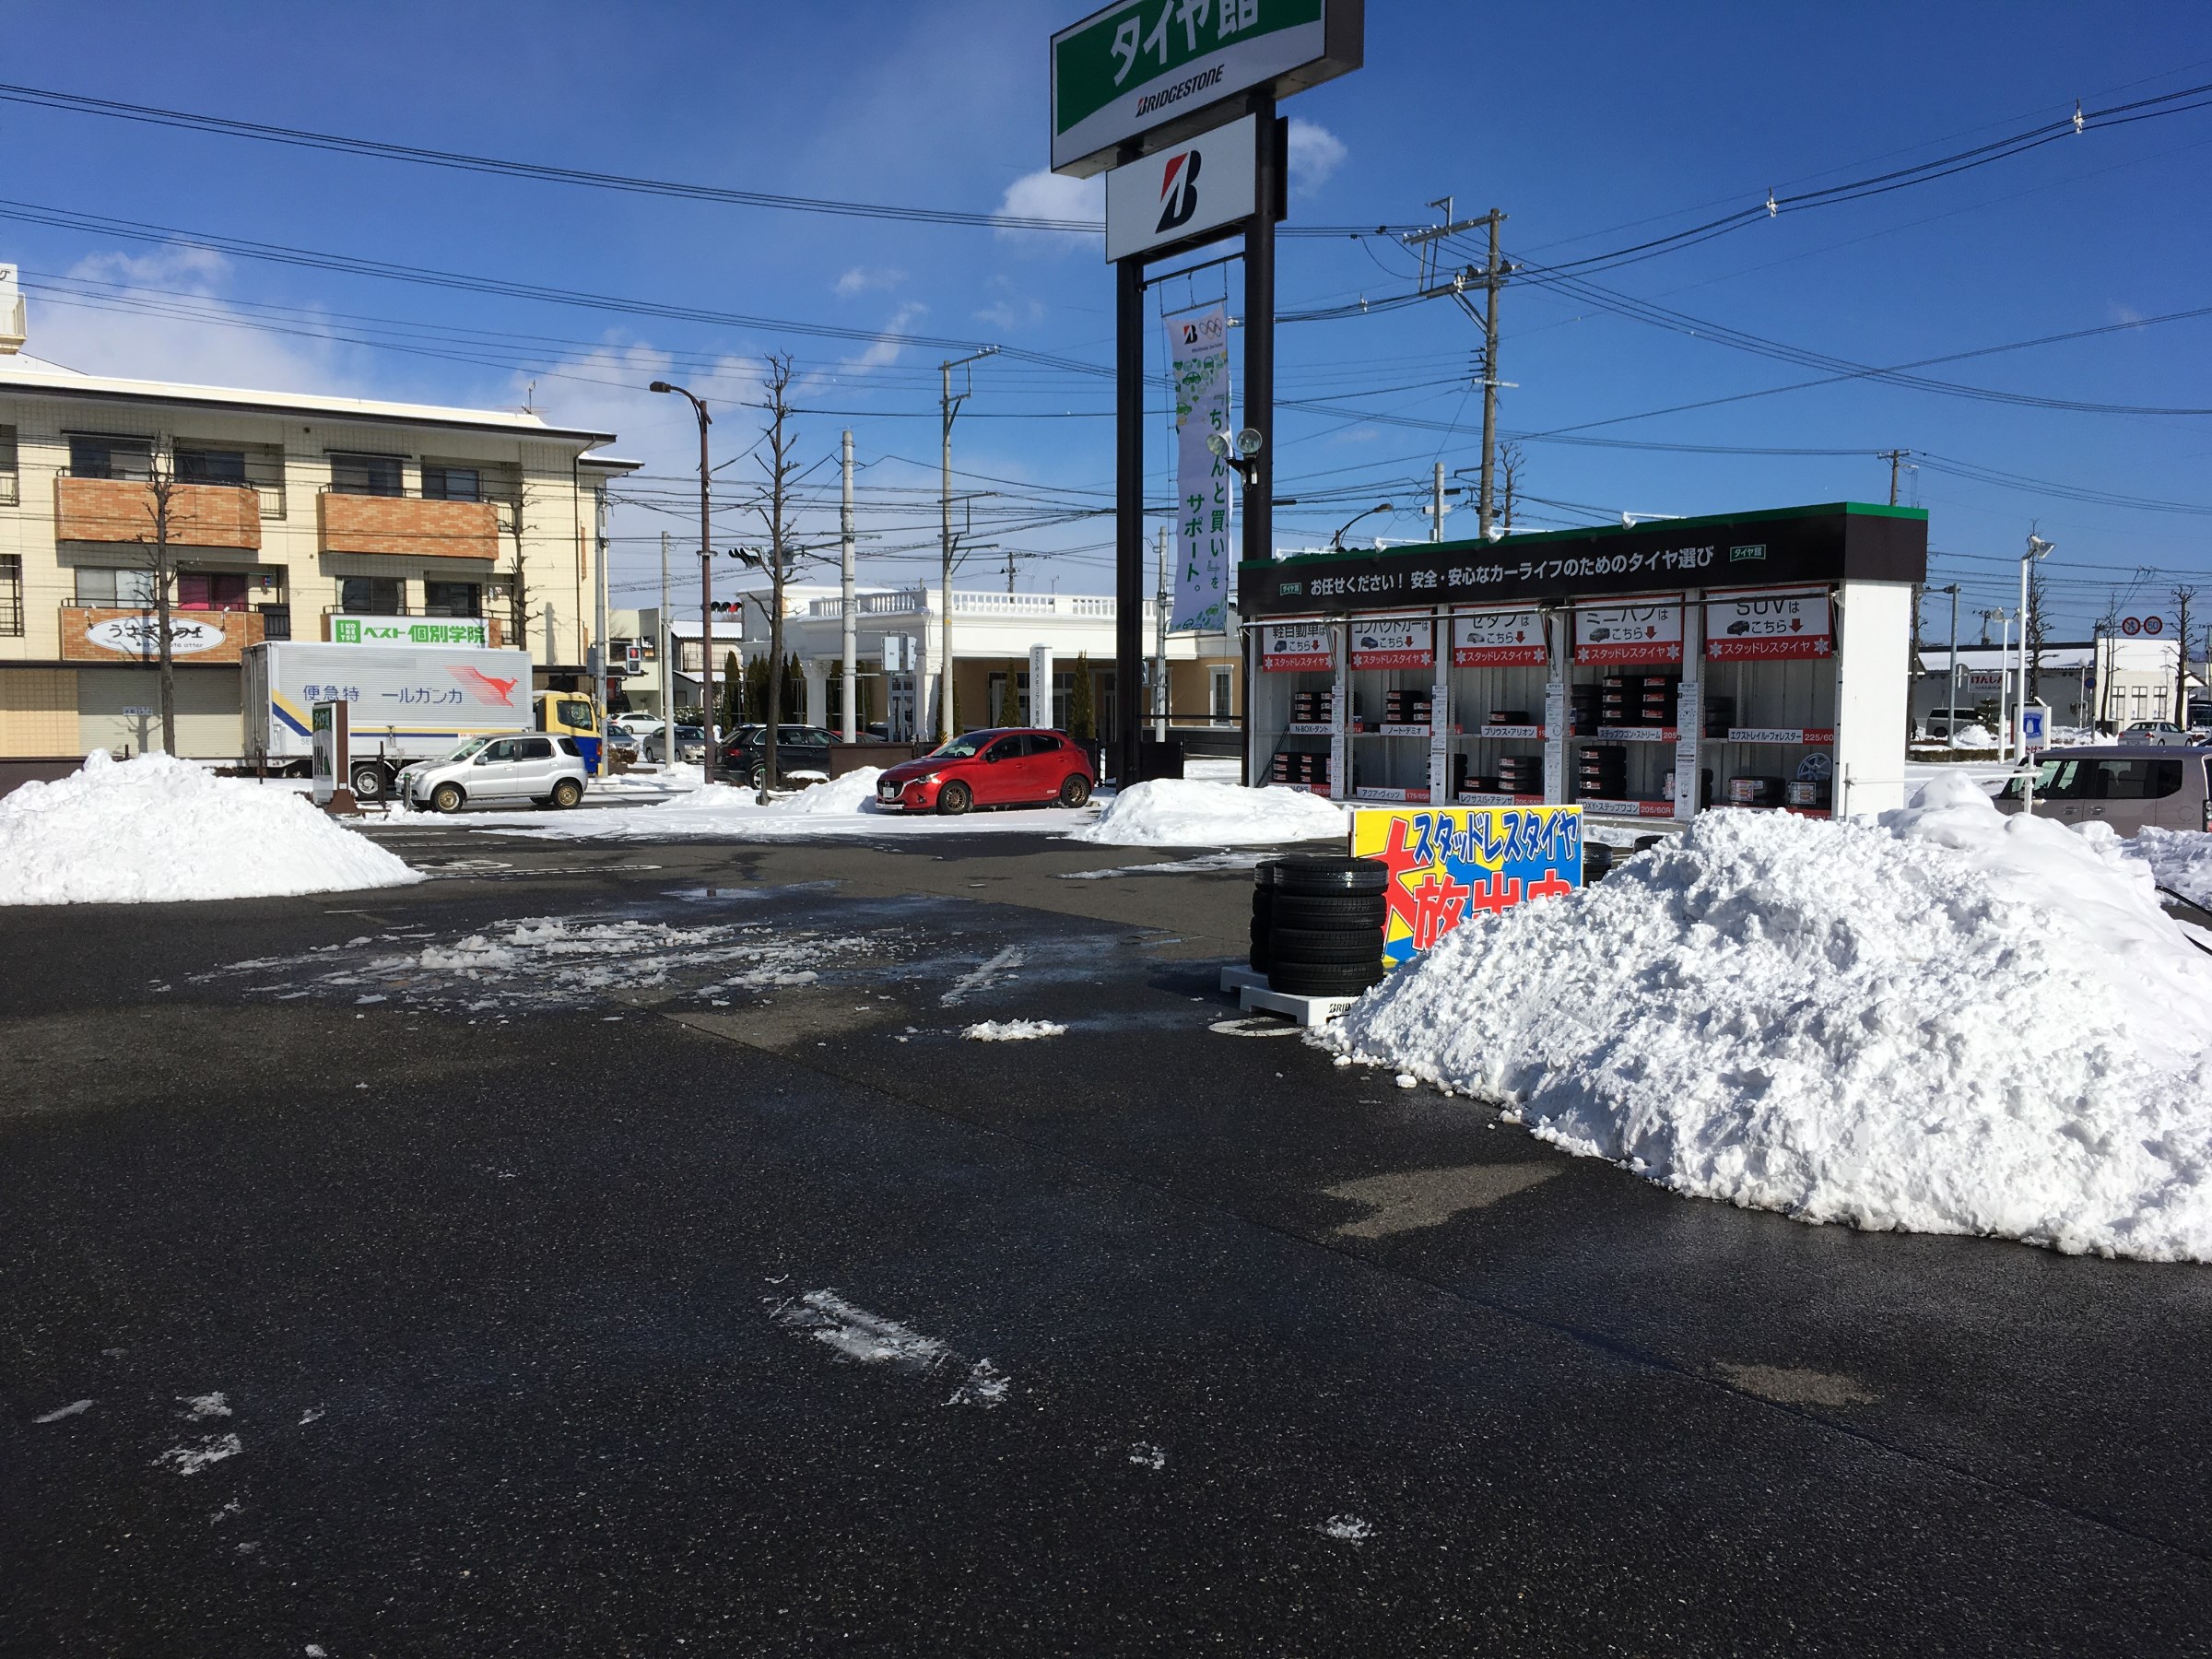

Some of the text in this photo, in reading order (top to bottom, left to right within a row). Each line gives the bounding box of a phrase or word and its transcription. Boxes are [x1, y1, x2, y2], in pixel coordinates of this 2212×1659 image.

[1135, 64, 1225, 118] BRIDGESTONE
[1207, 394, 1226, 590] 『ちんと買い』を
[1751, 619, 1787, 634] こちら
[2147, 620, 2159, 630] 50
[1487, 631, 1514, 644] こちら
[1612, 627, 1643, 641] こちら
[1288, 640, 1311, 652] こちら
[1380, 636, 1404, 649] こちら
[1724, 641, 1811, 655] スタッドレスタイヤ
[1362, 653, 1419, 665] スタッドレスタイヤ
[1466, 650, 1532, 663] スタッドレスタイヤ
[1591, 647, 1665, 660] スタッドレスタイヤ
[1274, 657, 1325, 667] スタッドレスタイヤ
[1413, 809, 1579, 865] スタッドレスタイヤ
[1328, 1003, 1351, 1014] BRID
